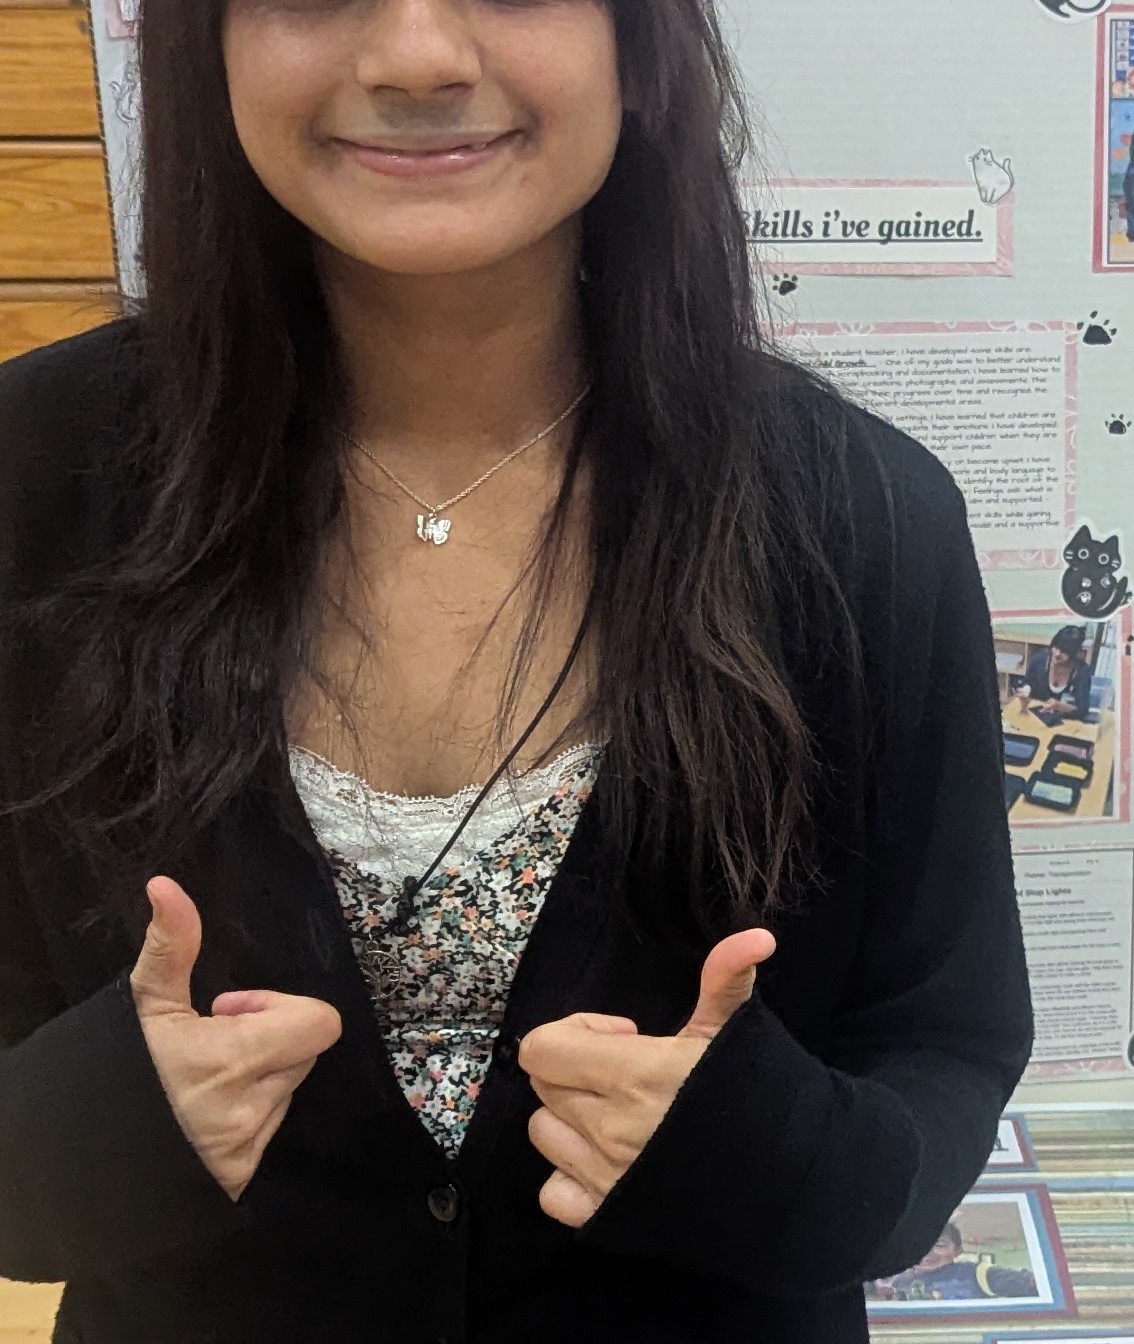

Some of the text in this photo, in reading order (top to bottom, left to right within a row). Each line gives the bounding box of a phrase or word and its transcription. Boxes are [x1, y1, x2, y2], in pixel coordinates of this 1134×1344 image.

[821, 210, 871, 238] i've
[877, 209, 983, 244] gained.
[929, 347, 968, 357] developed
[994, 346, 1013, 354] skills
[1016, 346, 1031, 354] are
[904, 358, 914, 366] of
[918, 359, 930, 368] my
[987, 356, 1013, 364] better
[1016, 355, 1061, 364] understand
[1000, 366, 1029, 374] learned
[958, 412, 986, 420] learned
[996, 422, 1015, 430] have
[1018, 422, 1057, 431] developed
[931, 434, 962, 444] support
[966, 432, 996, 440] children
[1023, 432, 1040, 441] they
[973, 466, 987, 474] and
[990, 467, 1008, 476] body
[1012, 466, 1045, 476] language
[986, 496, 1000, 504] and
[1027, 512, 1051, 520] gaining
[1018, 520, 1060, 530] supportive
